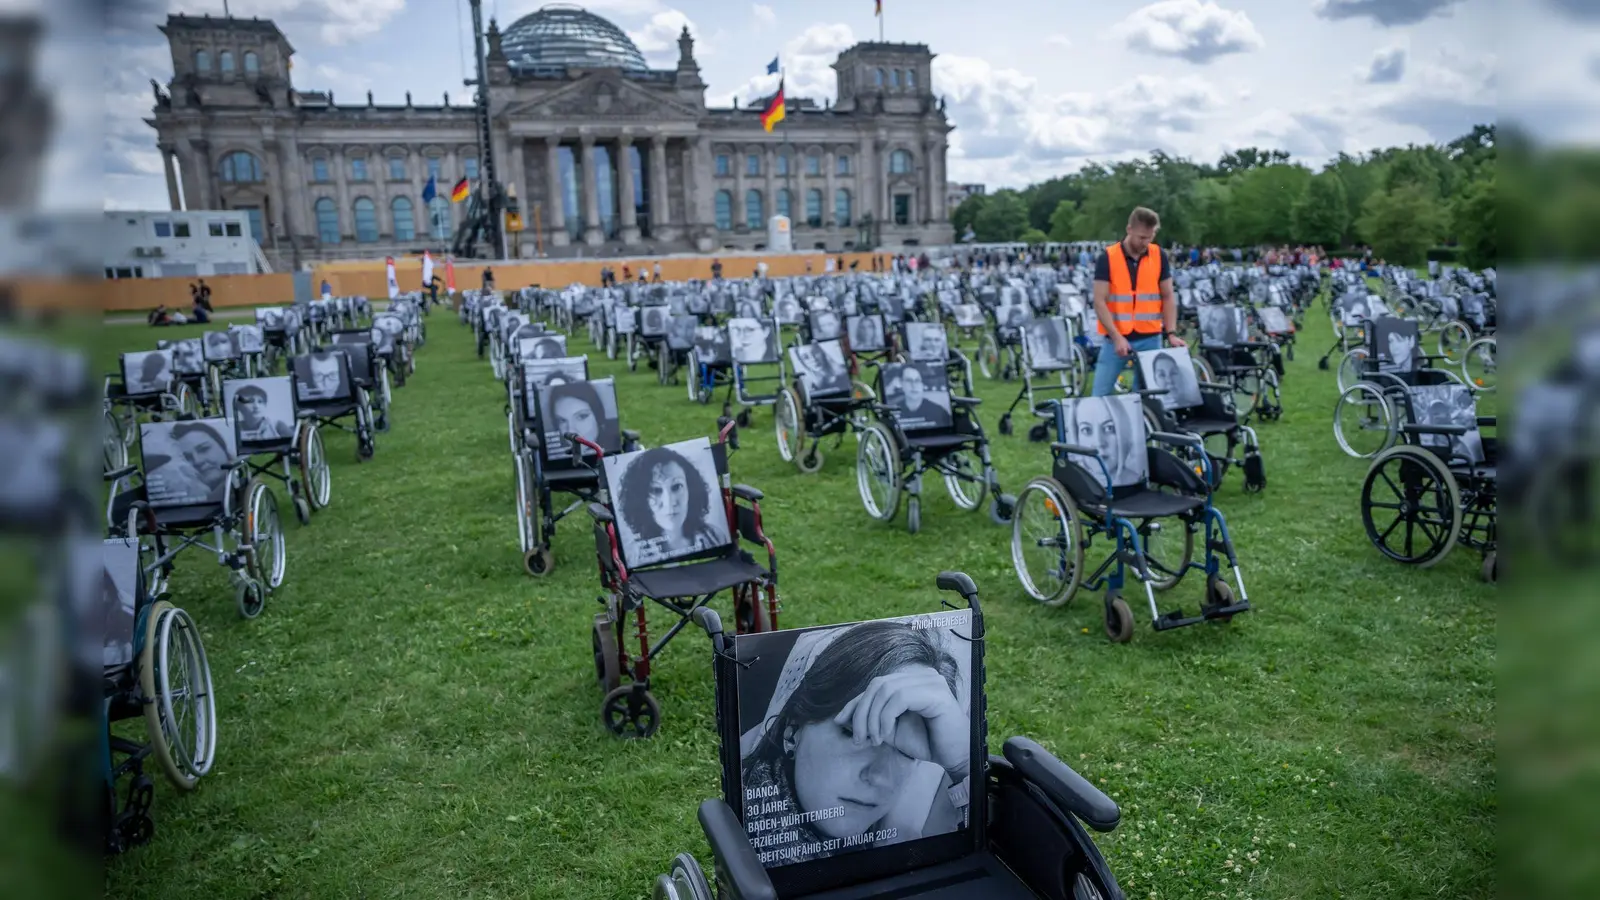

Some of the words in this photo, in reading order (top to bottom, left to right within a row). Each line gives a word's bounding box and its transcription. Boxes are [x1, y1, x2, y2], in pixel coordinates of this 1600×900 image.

[912, 614, 968, 630] #NICHTGENESEN
[747, 785, 779, 800] BIANCA
[747, 805, 759, 816] 30
[761, 800, 788, 814] JAHRE
[748, 806, 845, 832] BADEN-WÜRTTEMBERG
[823, 838, 840, 850] SEIT
[842, 833, 874, 847] JANUAR
[876, 828, 897, 841] 2023
